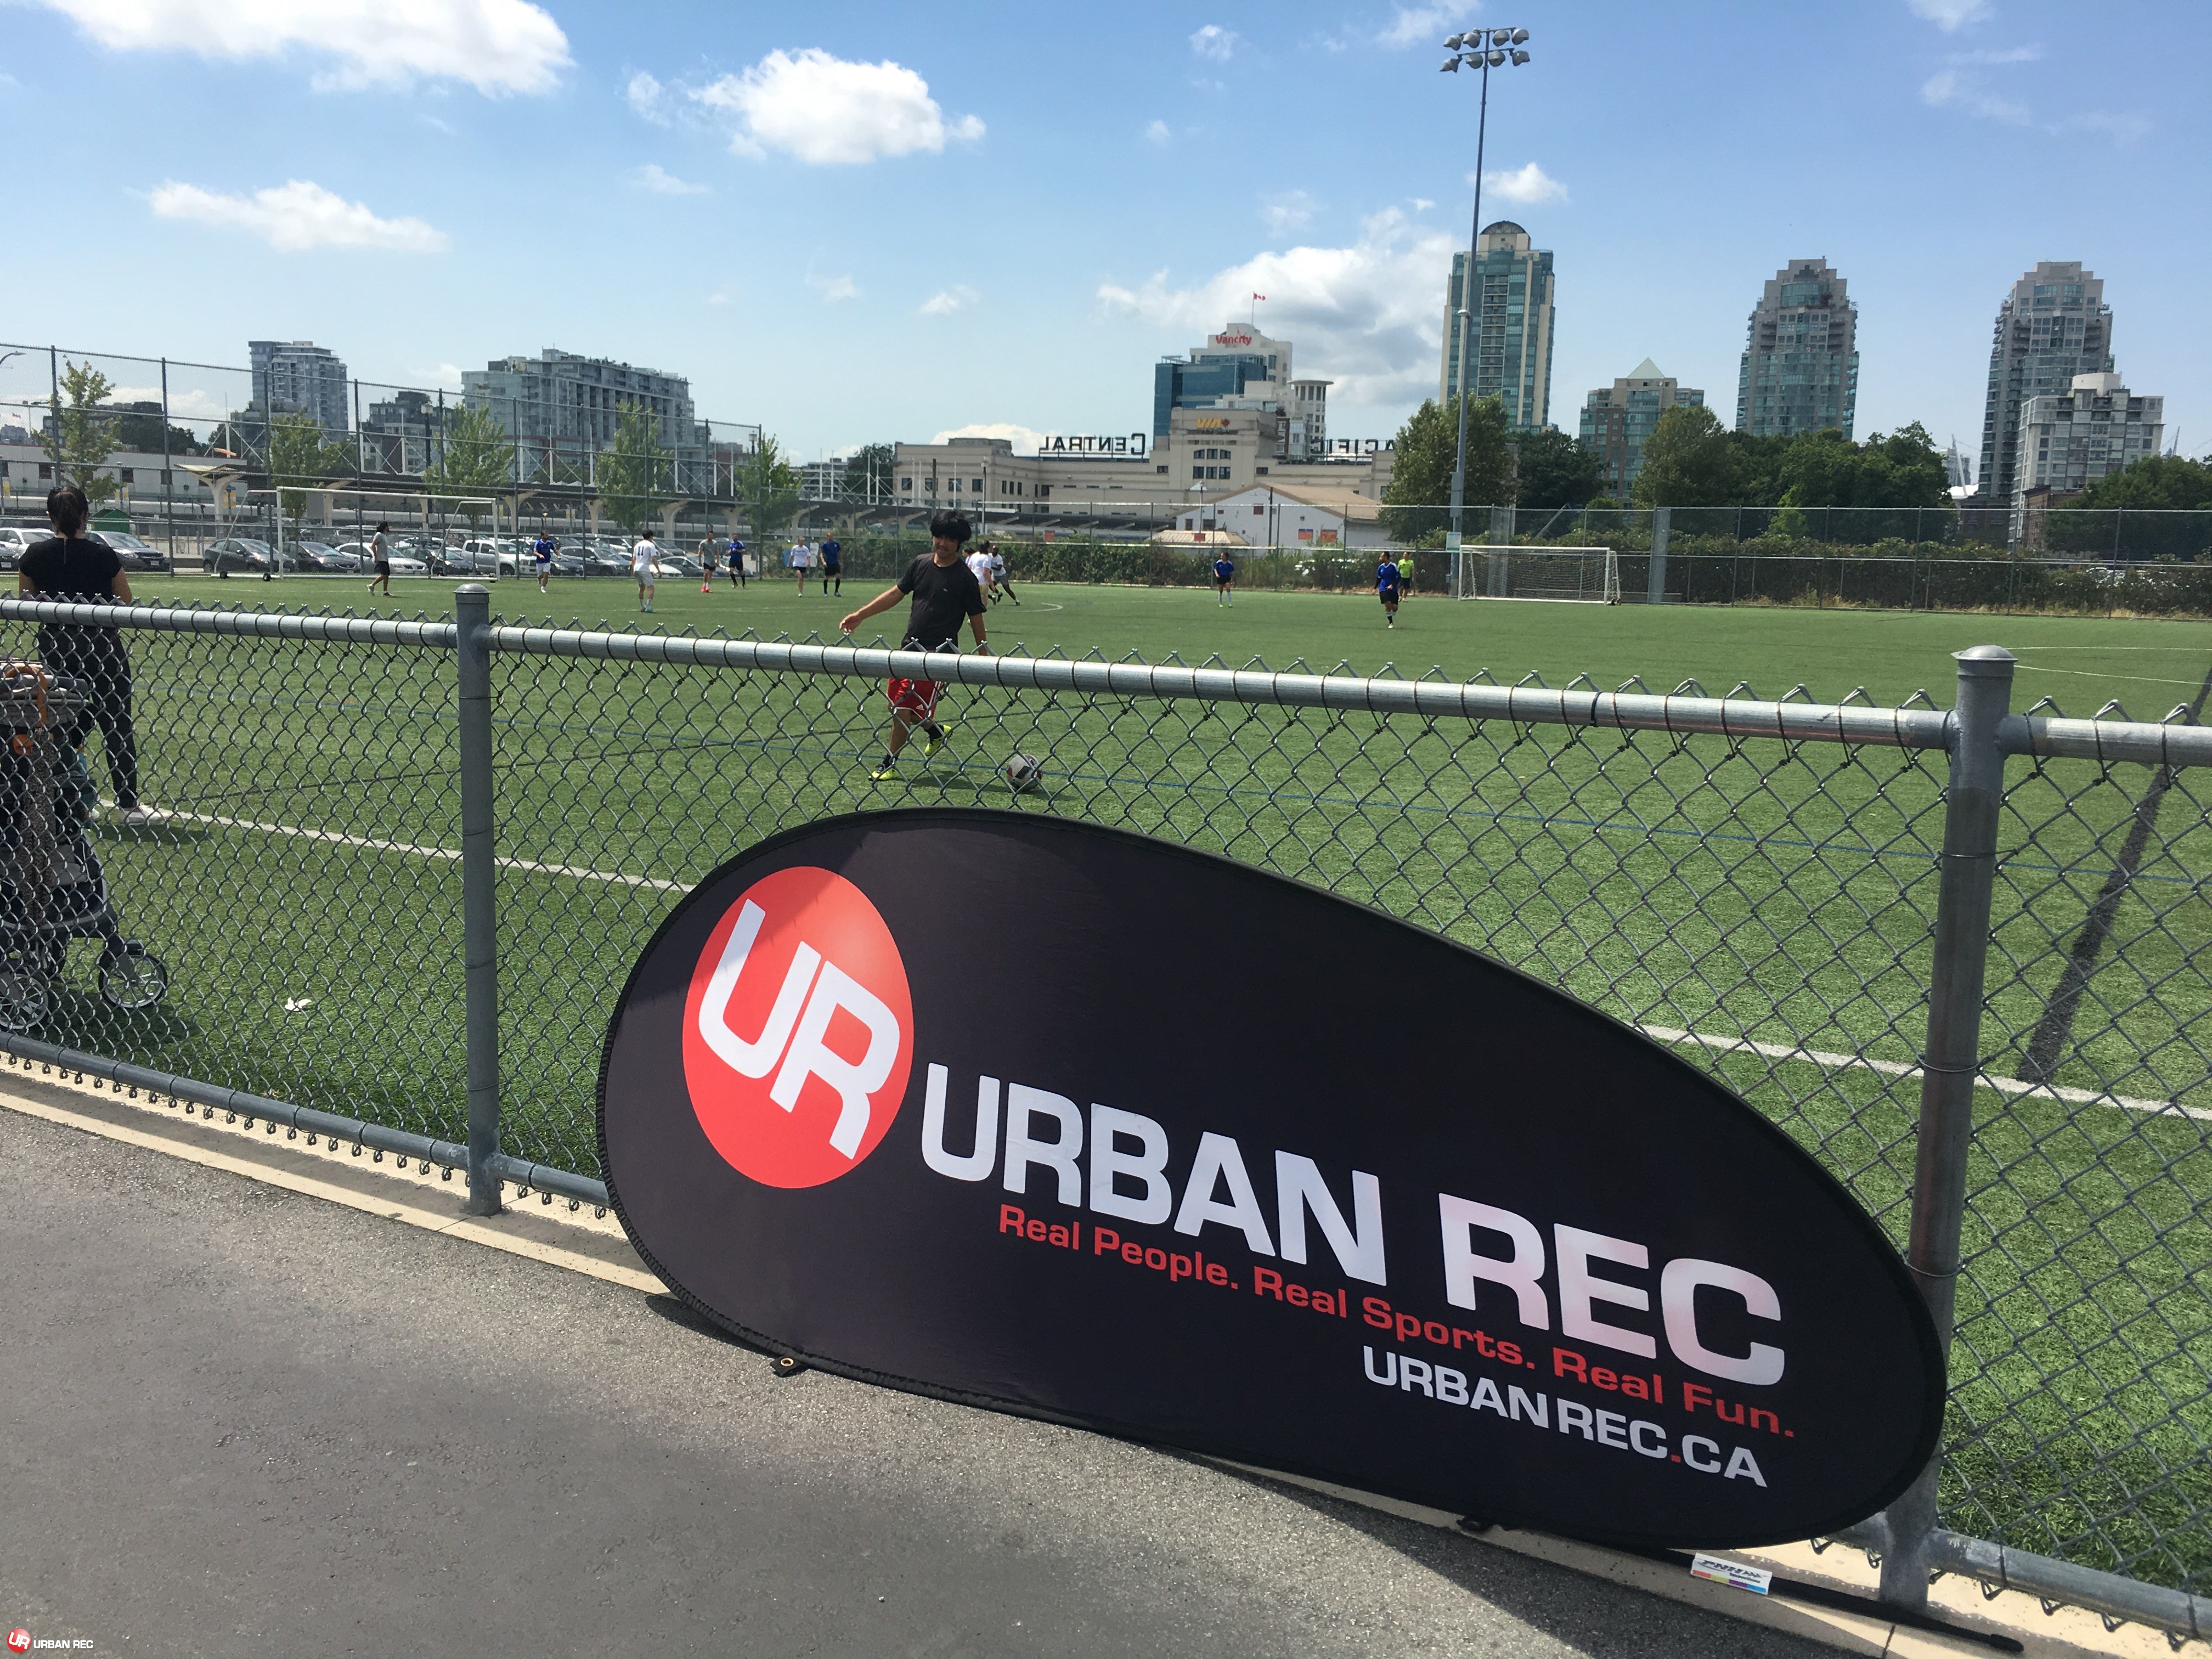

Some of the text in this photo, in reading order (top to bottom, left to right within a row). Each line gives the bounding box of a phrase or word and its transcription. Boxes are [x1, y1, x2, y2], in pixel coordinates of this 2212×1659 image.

[1216, 328, 1252, 346] Vancity
[1196, 418, 1221, 428] VIA
[637, 546, 644, 556] 11
[698, 899, 900, 1160] UR
[922, 1063, 1785, 1386] URBAN REC
[1000, 1204, 1795, 1437] Real People. Real Sports. Real Fun.
[1364, 1345, 1768, 1488] URBANREC.CA
